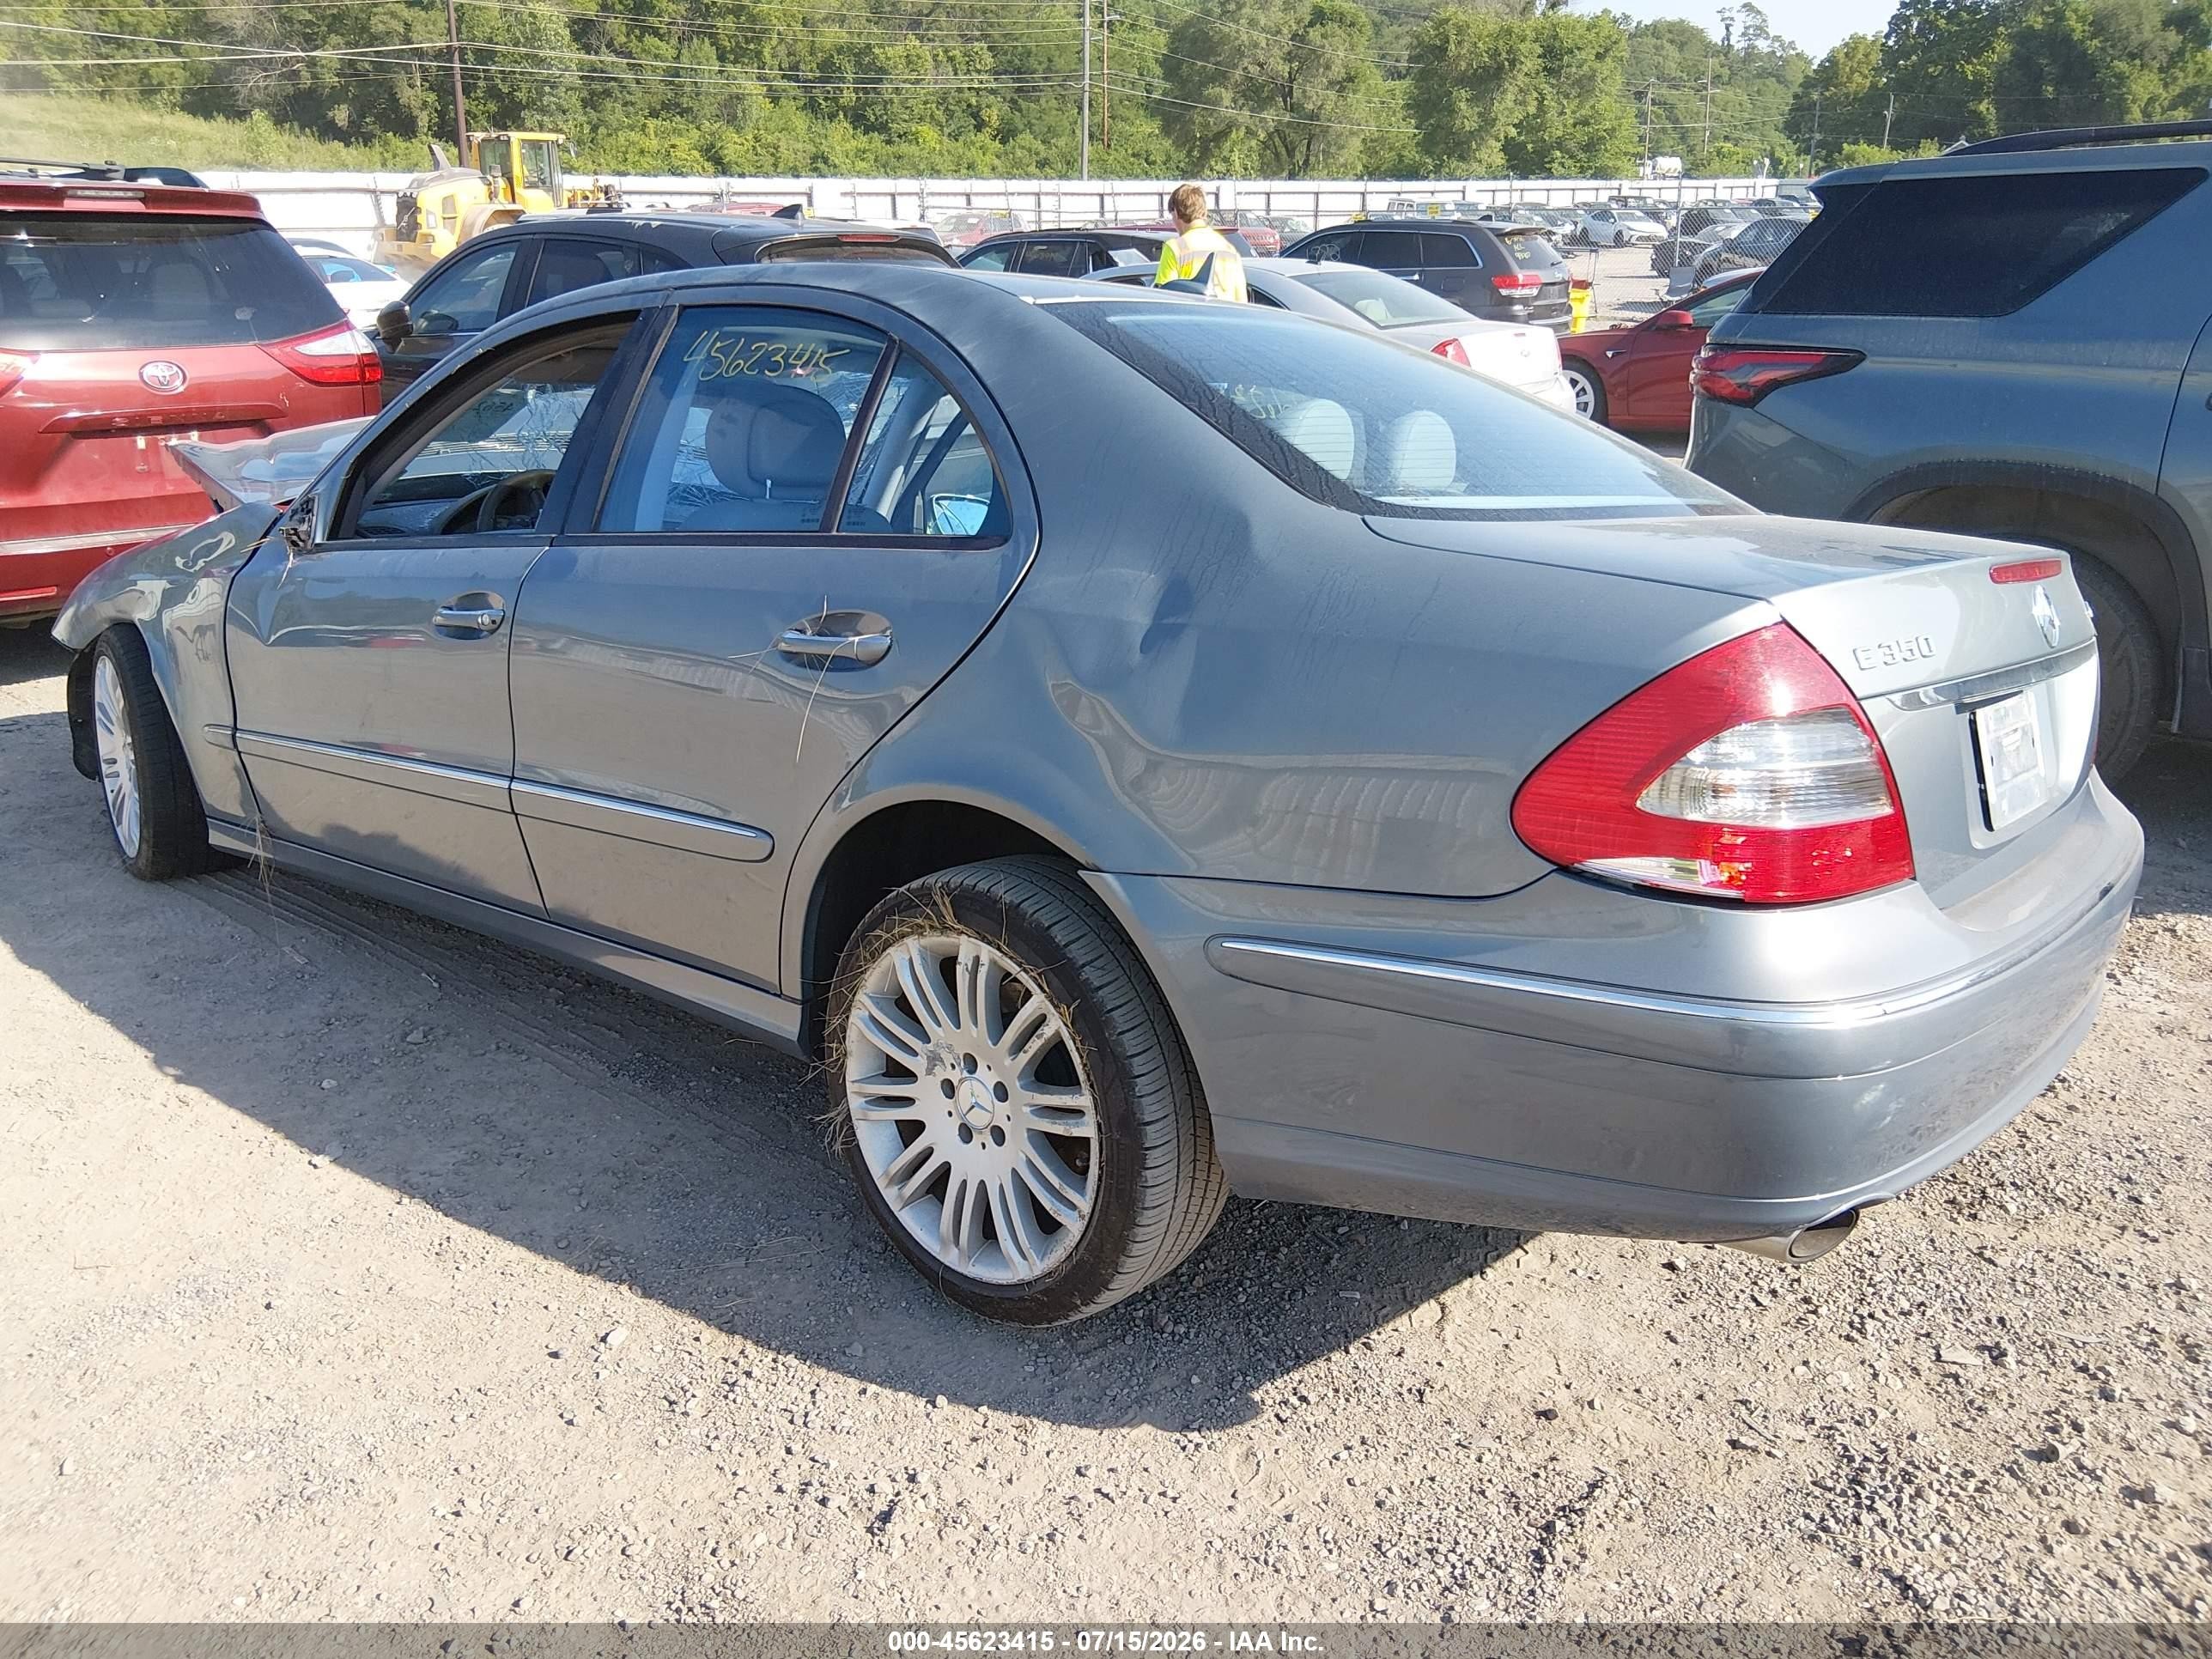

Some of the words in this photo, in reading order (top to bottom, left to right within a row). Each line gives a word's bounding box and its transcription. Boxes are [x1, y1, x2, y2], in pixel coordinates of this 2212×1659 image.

[683, 330, 851, 383] 45623415
[1852, 647, 1878, 671] E
[1877, 634, 1937, 666] 350
